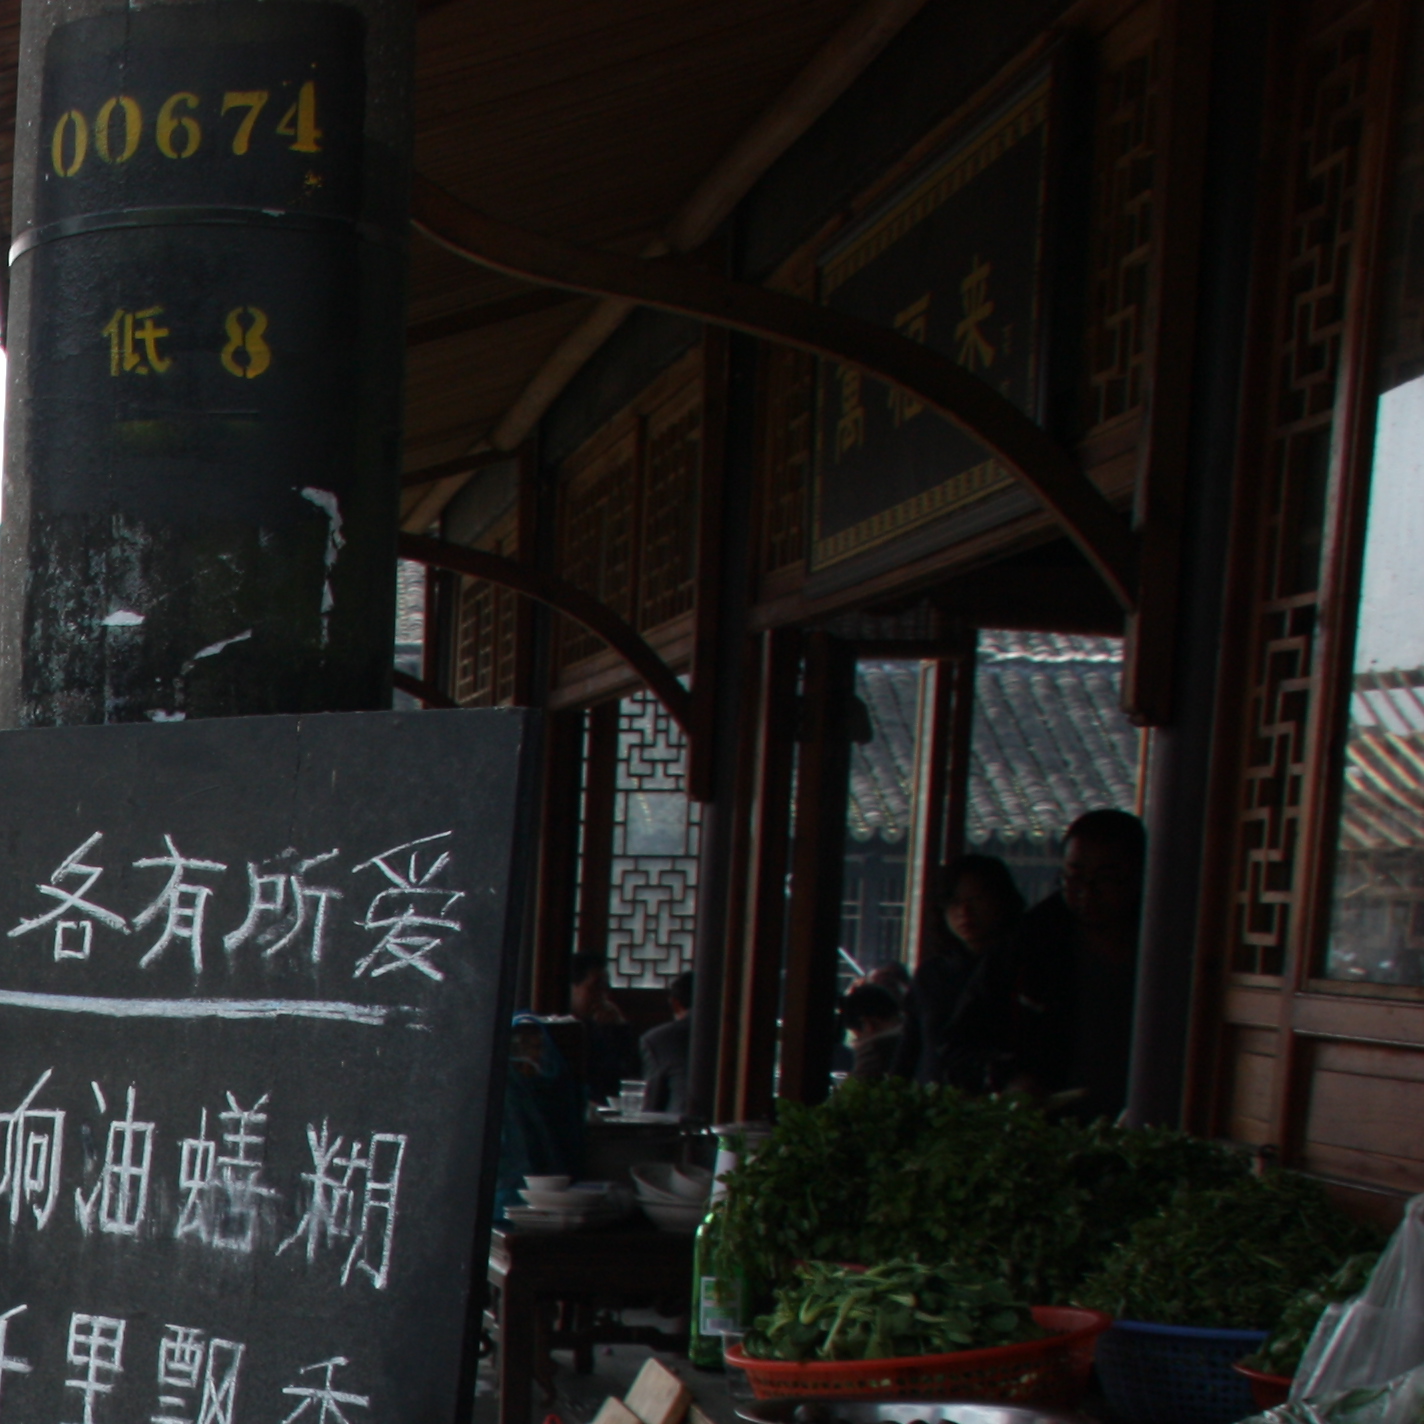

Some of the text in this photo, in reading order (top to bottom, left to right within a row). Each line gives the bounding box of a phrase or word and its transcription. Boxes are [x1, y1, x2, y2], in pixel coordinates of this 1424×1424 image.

[51, 79, 323, 178] 00674
[101, 305, 272, 379] 低 8
[7, 829, 466, 982] 各有所爱
